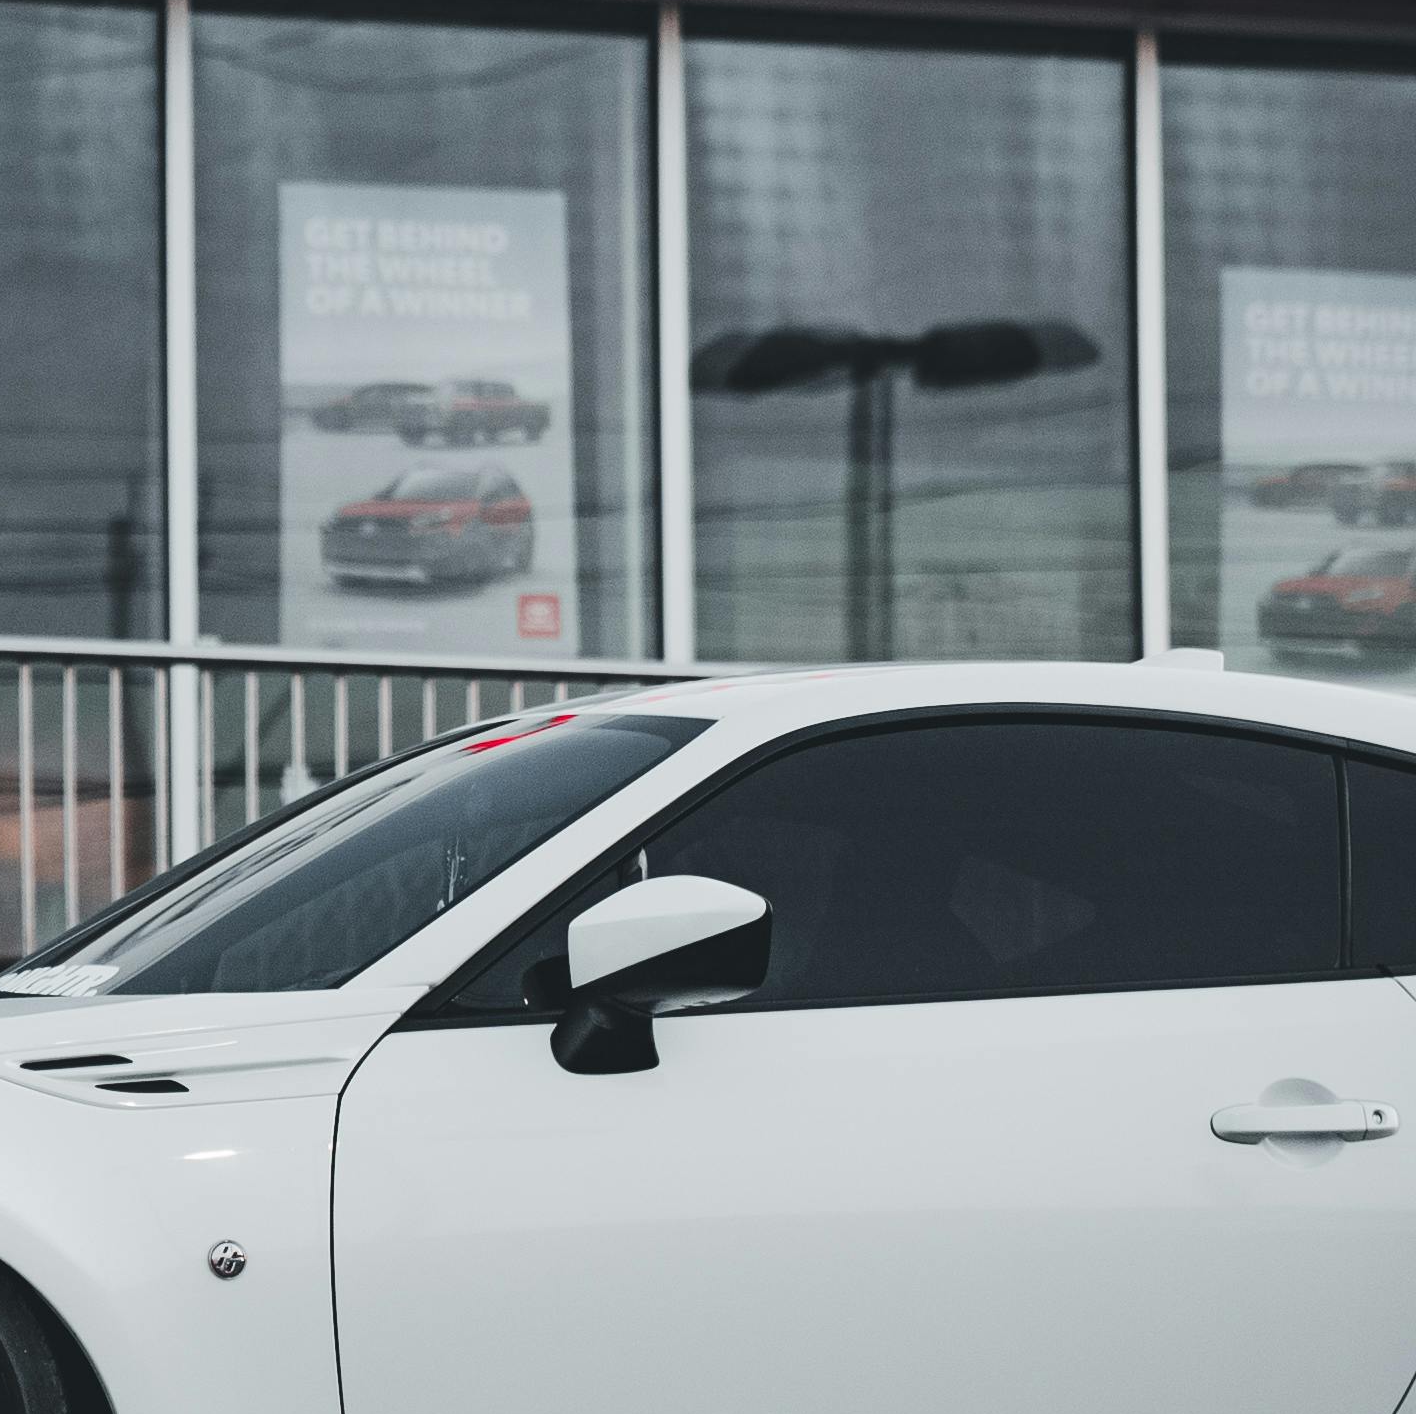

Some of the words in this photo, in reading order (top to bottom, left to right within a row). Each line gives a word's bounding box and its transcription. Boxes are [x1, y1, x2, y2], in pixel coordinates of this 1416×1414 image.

[305, 217, 371, 248] GET
[377, 219, 510, 255] BEHIND
[306, 251, 372, 284] THE
[378, 256, 498, 287] WHEEL
[305, 286, 353, 316] OF
[361, 287, 384, 317] A
[388, 290, 533, 321] WINNER
[1245, 303, 1307, 336] GET
[1314, 306, 1416, 337] BEHIN
[1246, 339, 1309, 371] THE
[1297, 371, 1324, 401] A
